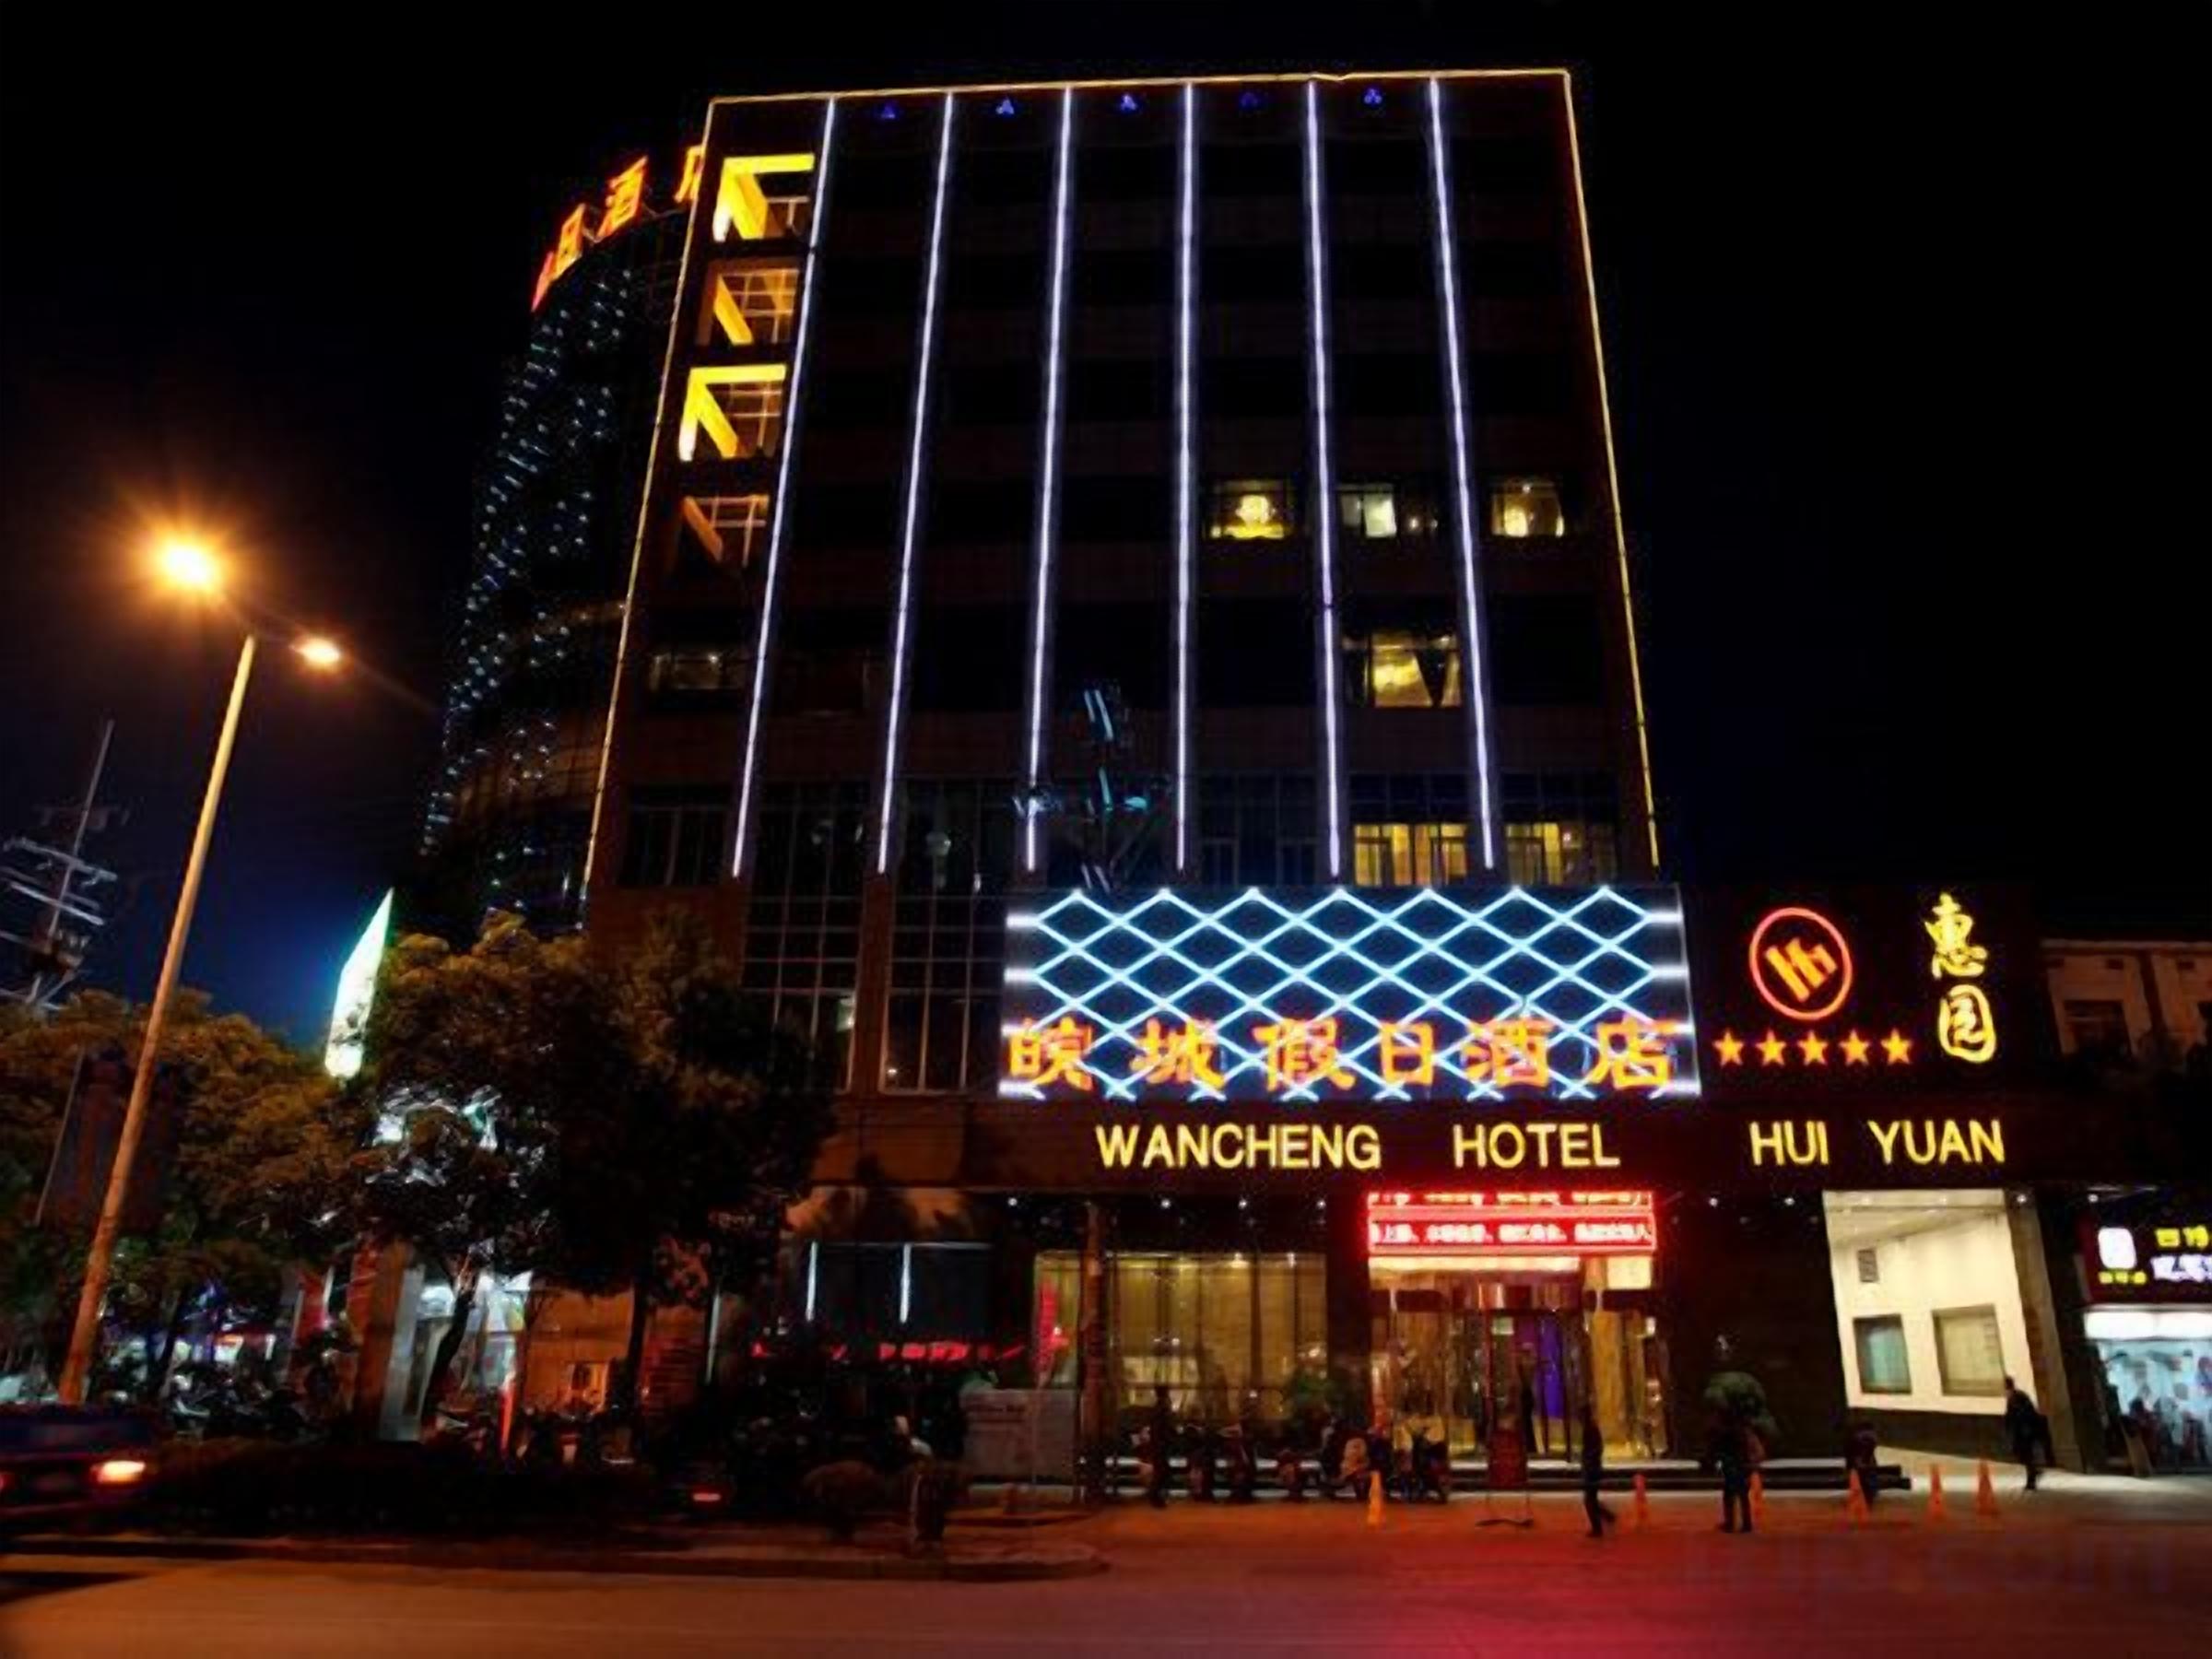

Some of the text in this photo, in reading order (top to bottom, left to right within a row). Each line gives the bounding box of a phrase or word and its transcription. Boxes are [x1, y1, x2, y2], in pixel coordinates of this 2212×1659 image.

[1924, 892, 1997, 1064] 惠园
[1095, 1122, 1621, 1171] WANCHENG HOTEL
[1749, 1119, 2006, 1167] HUI YUAN
